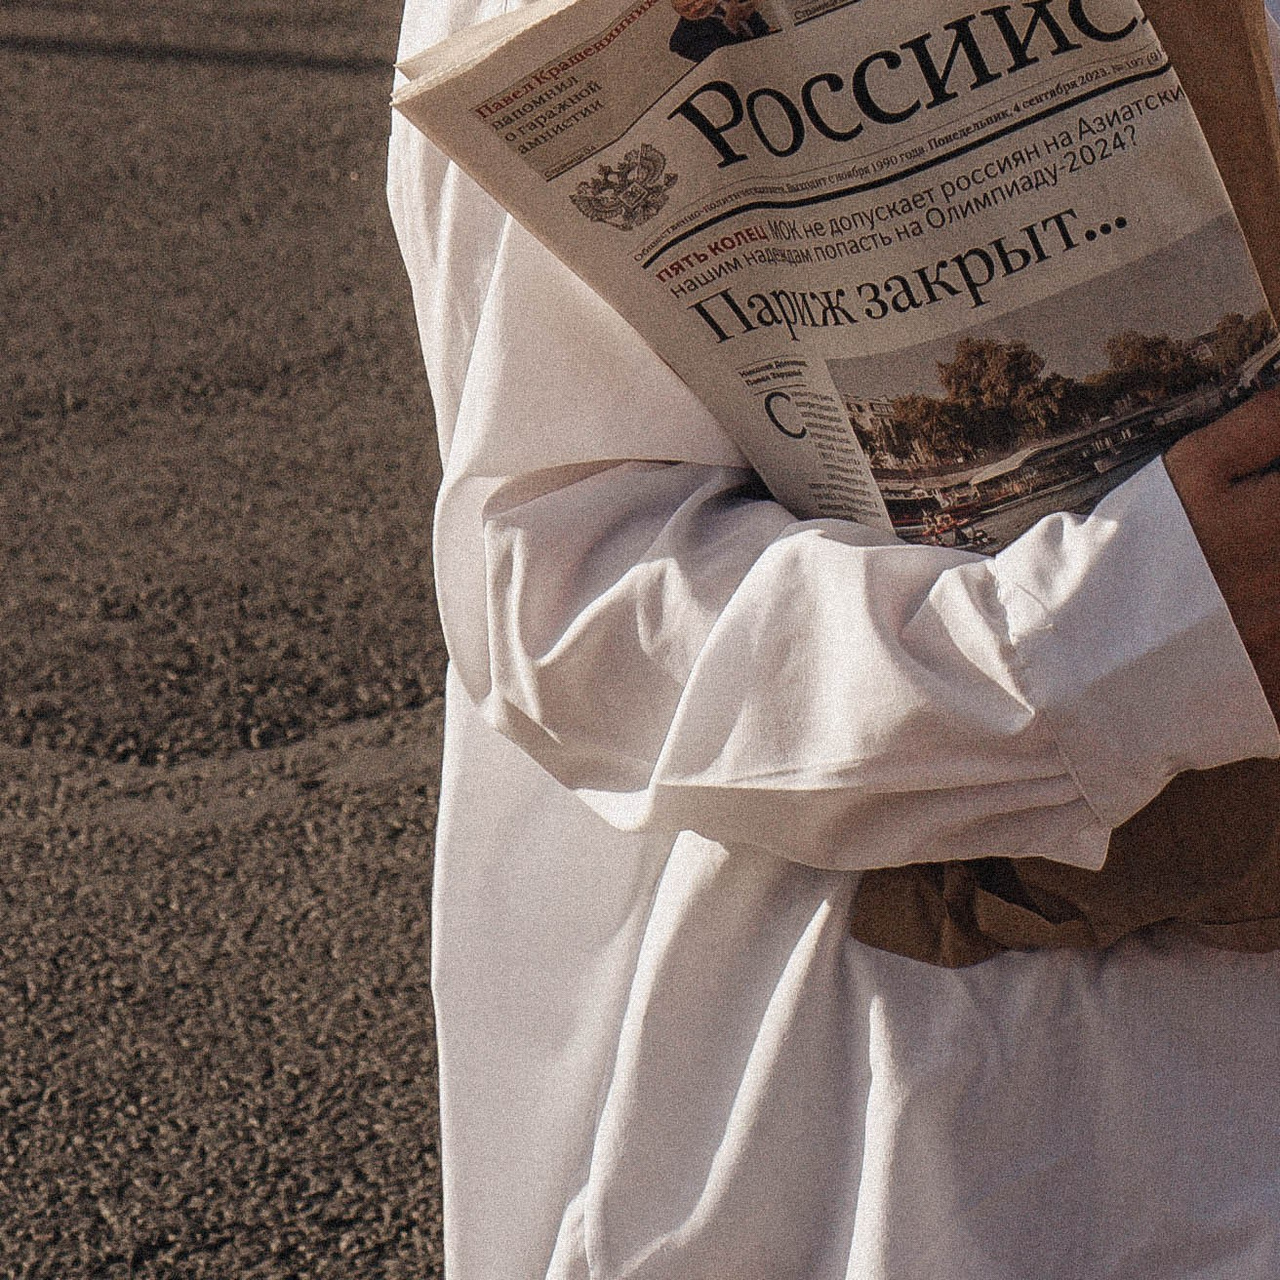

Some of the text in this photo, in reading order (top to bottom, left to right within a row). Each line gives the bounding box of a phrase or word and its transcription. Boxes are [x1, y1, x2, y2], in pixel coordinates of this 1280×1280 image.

[474, 83, 535, 120] Павел
[490, 75, 579, 132] напомнил
[504, 79, 603, 143] о гаражной
[517, 99, 605, 156] амнистии
[871, 155, 899, 174] 1990
[655, 248, 709, 283] ПЯТЬ
[708, 224, 770, 257] КОЛЕЦ
[767, 218, 800, 243] МОК
[803, 220, 827, 238] не
[829, 187, 935, 238] допускает
[939, 144, 1041, 205] россиян
[1043, 130, 1075, 156] на
[669, 124, 1138, 299] нашим надеждам попасть на Олимпиаду-2024?
[687, 207, 1129, 345] Париж закрыт...
